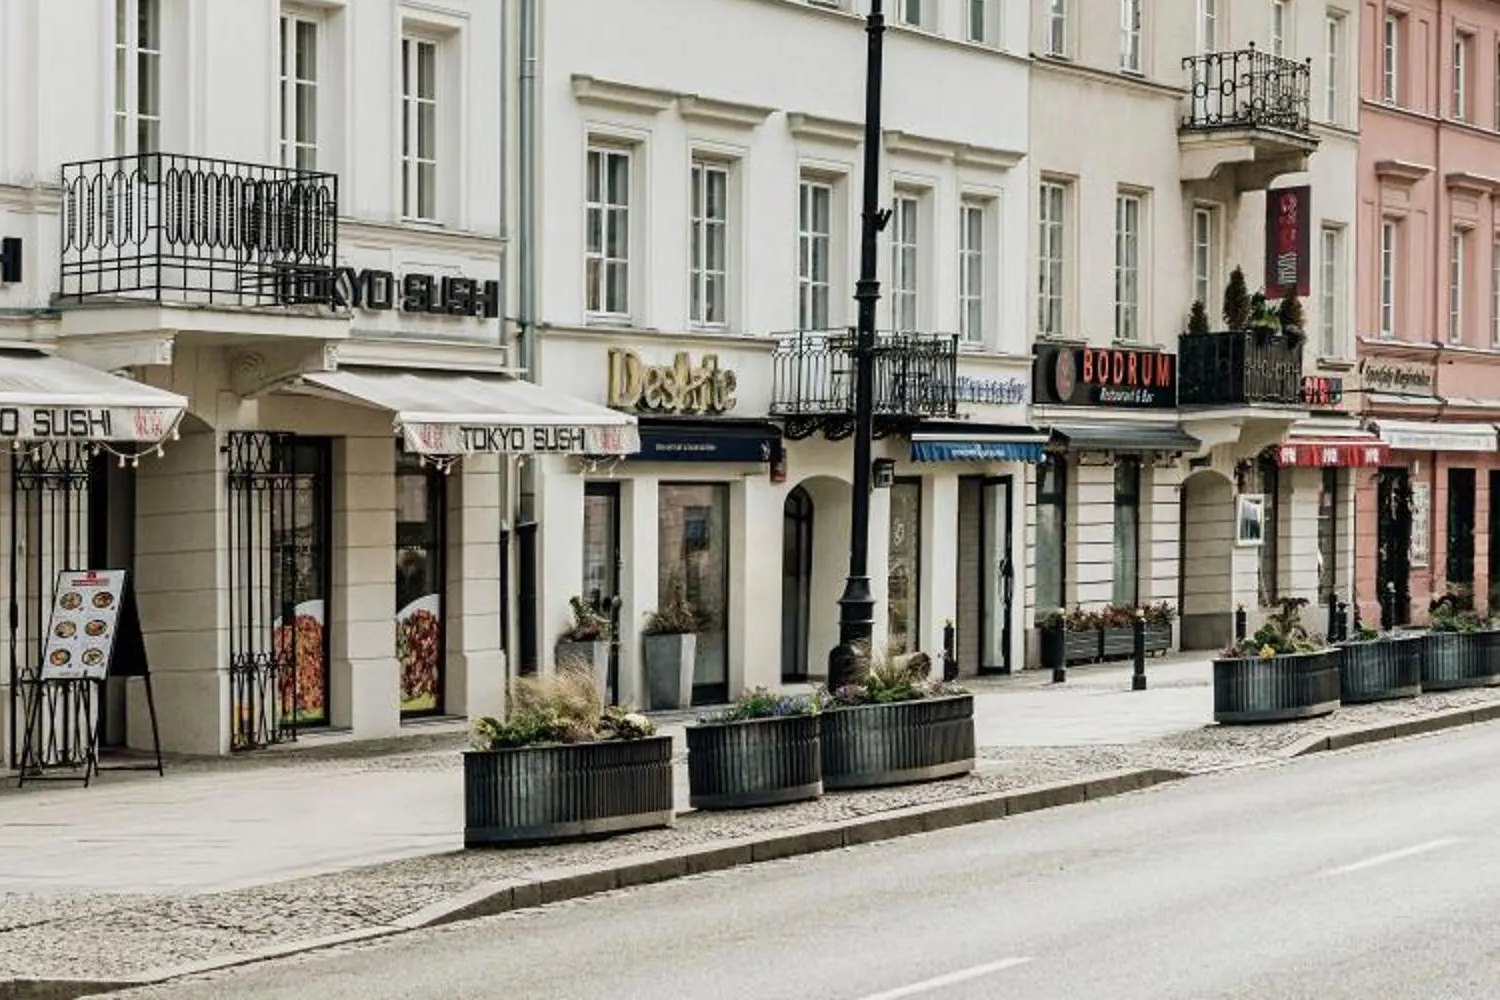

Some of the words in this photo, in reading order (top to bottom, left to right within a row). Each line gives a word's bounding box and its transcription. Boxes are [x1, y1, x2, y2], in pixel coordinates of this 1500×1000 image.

[1083, 347, 1170, 387] BODRUM
[33, 409, 112, 437] SUSHI
[460, 426, 525, 451] TOKYO
[533, 427, 585, 451] SUSHI
